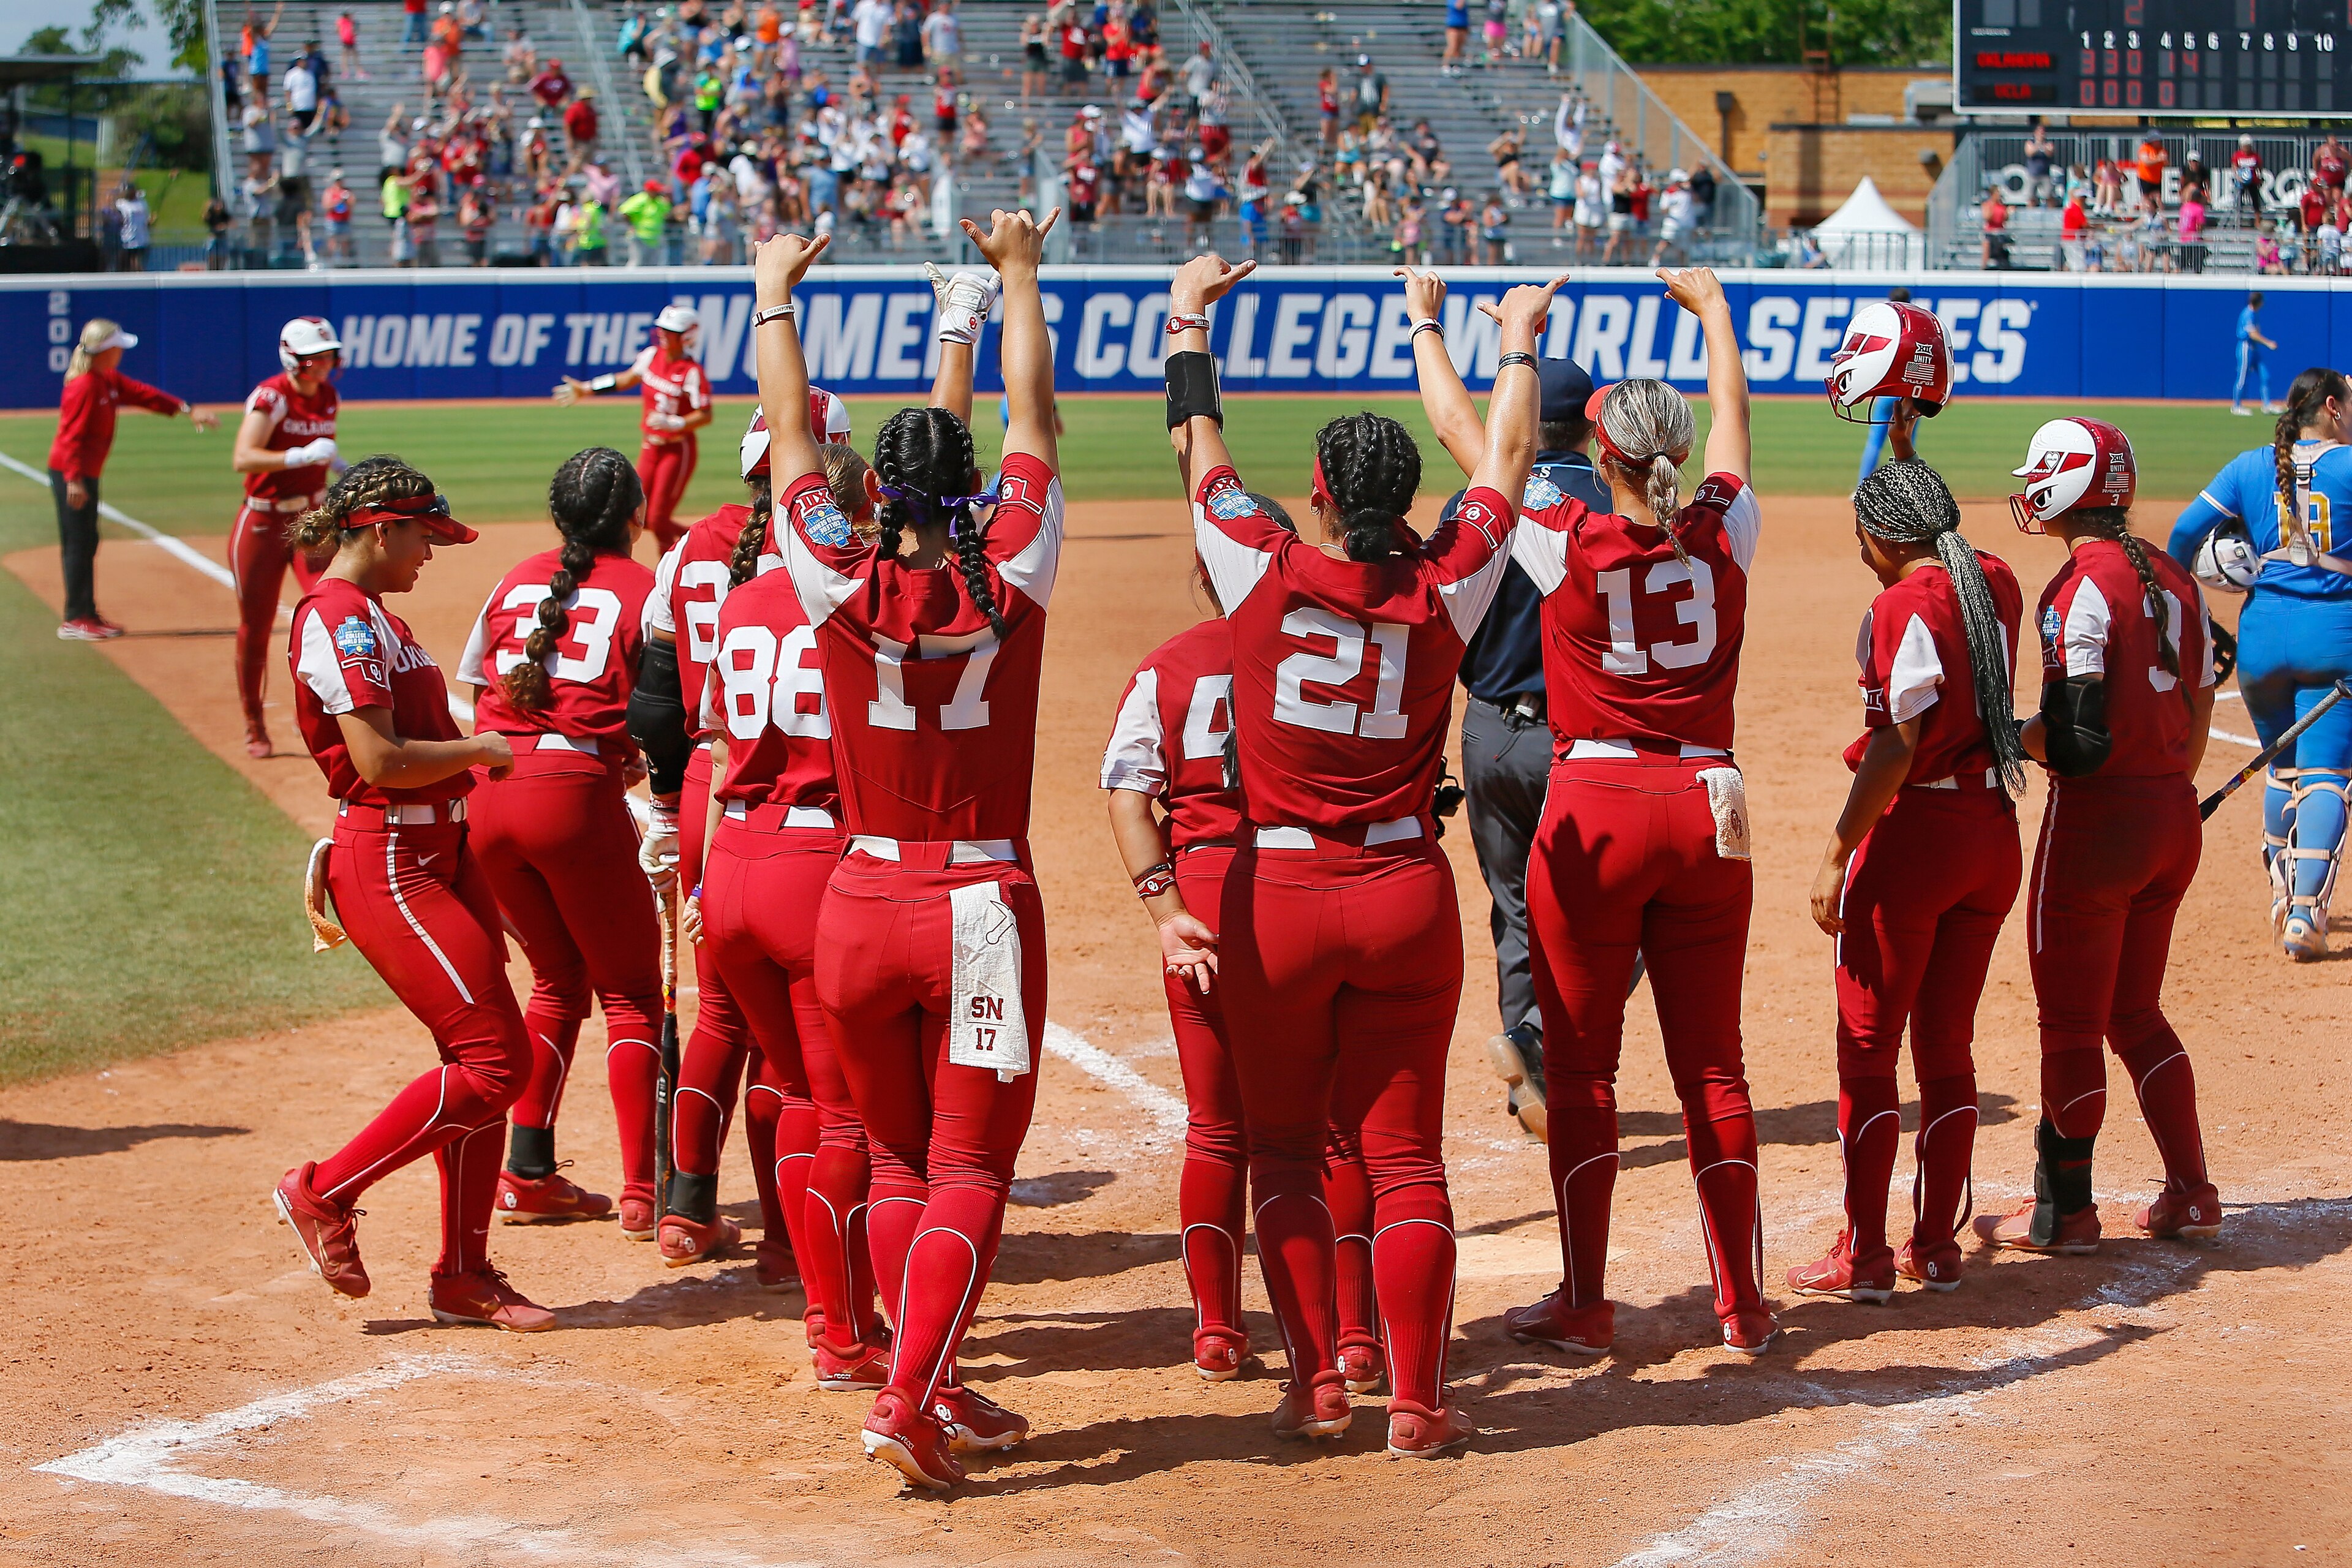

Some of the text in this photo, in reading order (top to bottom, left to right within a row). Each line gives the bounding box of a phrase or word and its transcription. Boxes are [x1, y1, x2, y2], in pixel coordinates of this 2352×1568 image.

[2080, 30, 2334, 52] 1 2 3 4 5 6 7 8 9 10
[2081, 49, 2095, 75] 3
[2104, 49, 2119, 75] 3
[2127, 49, 2142, 75] 0
[1994, 79, 2174, 106] UCLA 0 0 0 0
[1170, 318, 1180, 330] OU
[341, 314, 482, 368] HOME
[488, 313, 555, 367] OF
[564, 312, 654, 366] THE
[1741, 296, 2032, 384] SEES
[1914, 354, 1932, 364] UNITY
[2111, 494, 2120, 506] 3
[809, 519, 826, 534] SERIES
[819, 521, 841, 535] COLLEGE
[1597, 556, 1717, 674] 13
[496, 584, 622, 684] 33
[869, 626, 1001, 730] 17
[1273, 606, 1409, 739] 21
[1147, 881, 1159, 892] OU
[971, 997, 1004, 1020] SN
[976, 1028, 997, 1051] 17
[2189, 1206, 2201, 1221] OU
[1928, 1262, 1937, 1277] OU
[935, 1404, 952, 1422] OU
